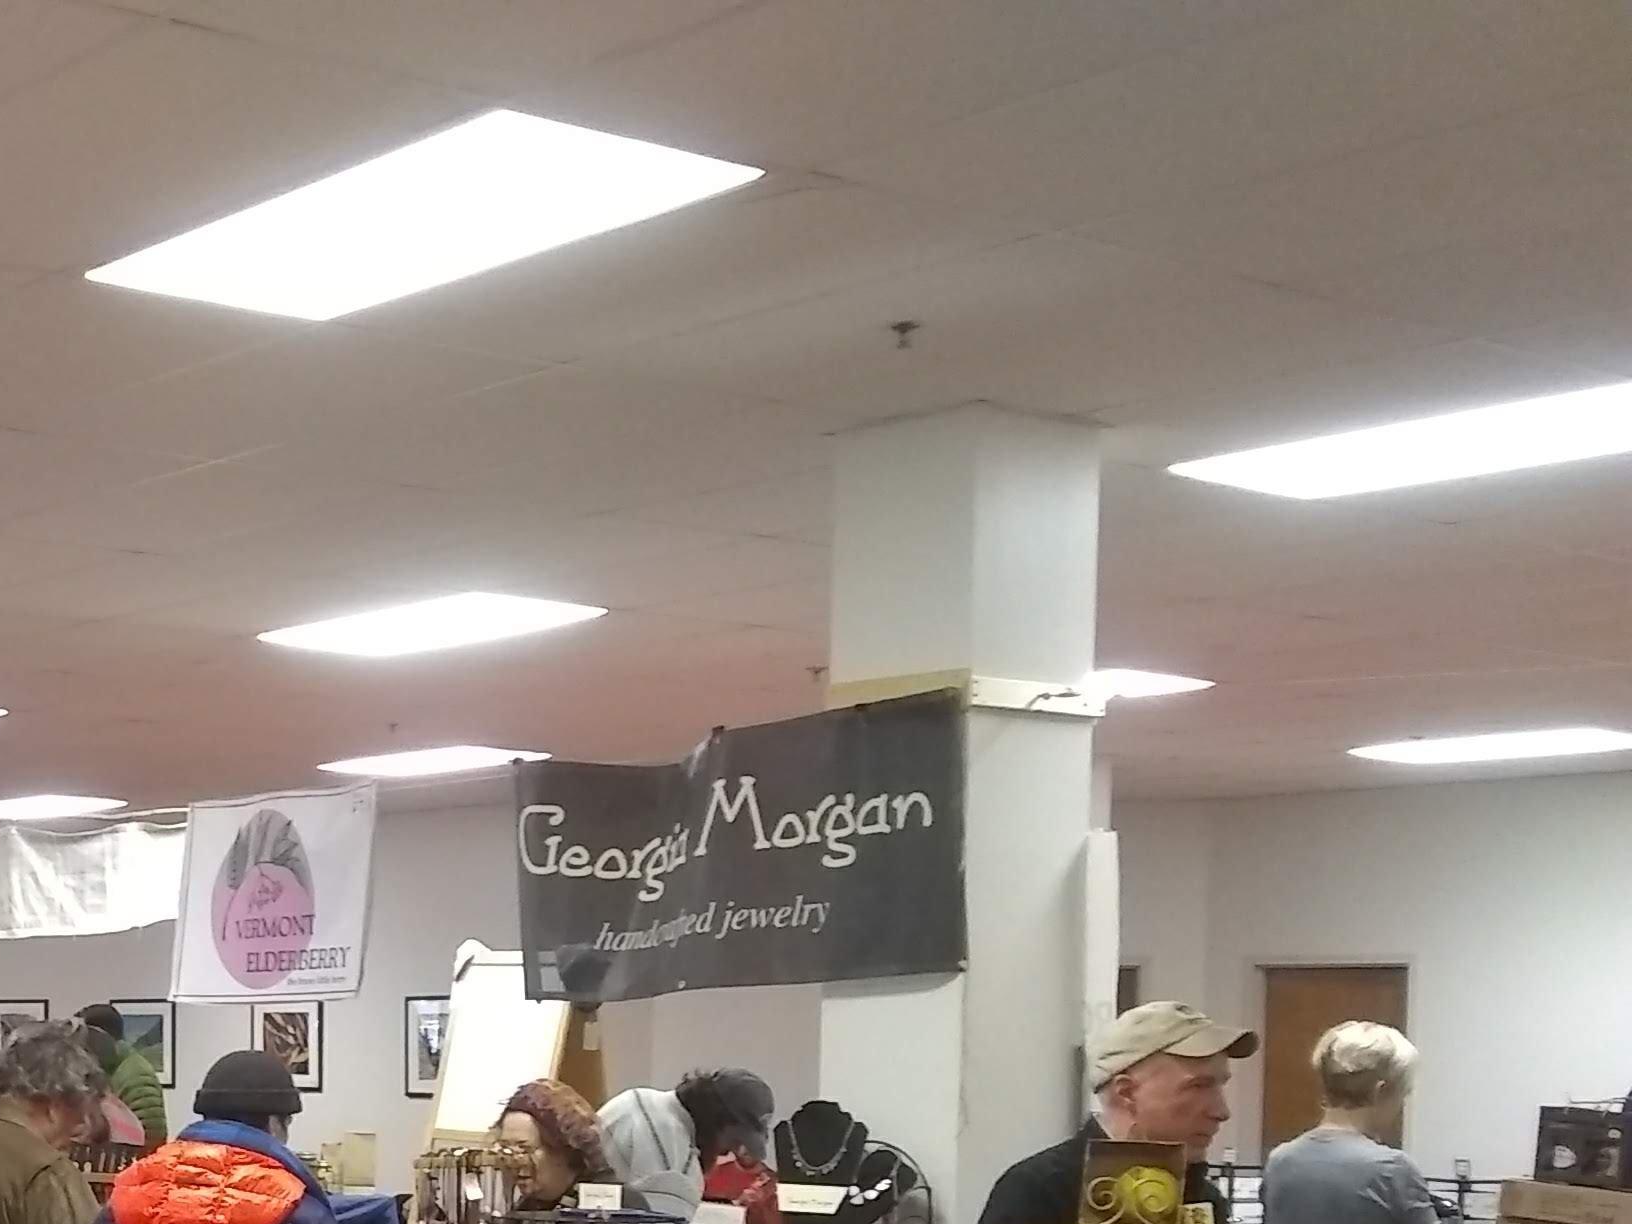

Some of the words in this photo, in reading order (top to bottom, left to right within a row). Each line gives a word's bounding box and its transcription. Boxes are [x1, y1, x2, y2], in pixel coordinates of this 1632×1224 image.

[694, 775, 933, 868] Morgan
[234, 914, 316, 939] VERMONT
[714, 894, 831, 939] jewelry
[246, 946, 351, 973] ELDERBERRY
